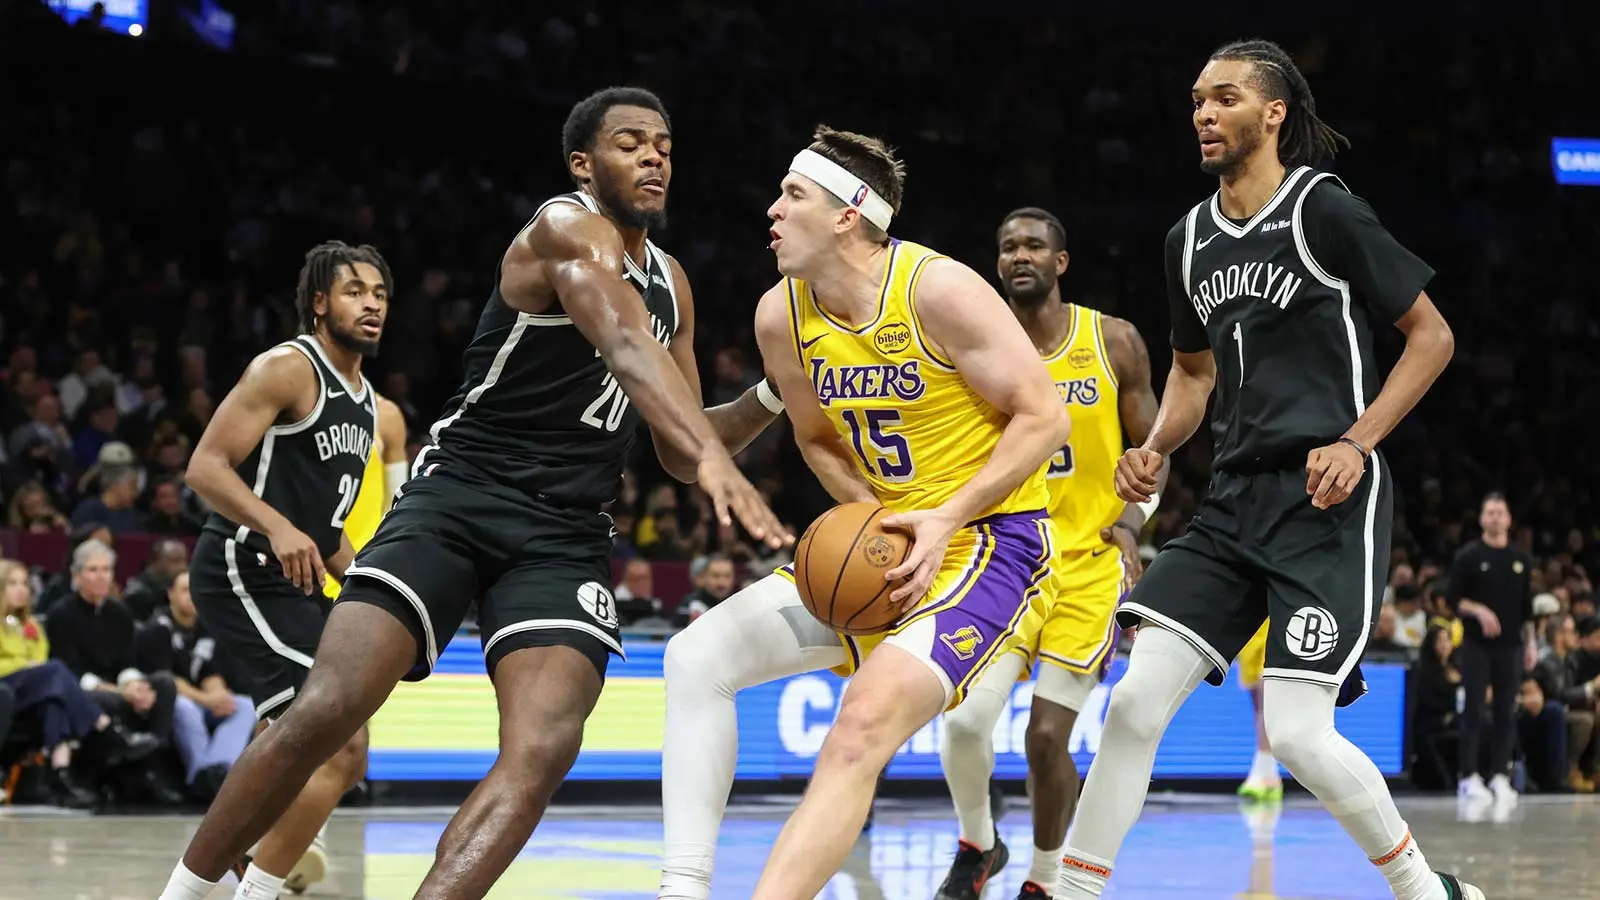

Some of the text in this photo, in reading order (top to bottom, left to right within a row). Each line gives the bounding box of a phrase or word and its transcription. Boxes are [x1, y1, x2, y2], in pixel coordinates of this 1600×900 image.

[1192, 262, 1302, 326] BROOKLYN
[877, 331, 910, 344] bibigo
[1232, 322, 1244, 389] 1
[580, 371, 630, 432] 20
[811, 357, 927, 407] LAKERS
[841, 409, 915, 482] 15
[1300, 612, 1322, 653] B
